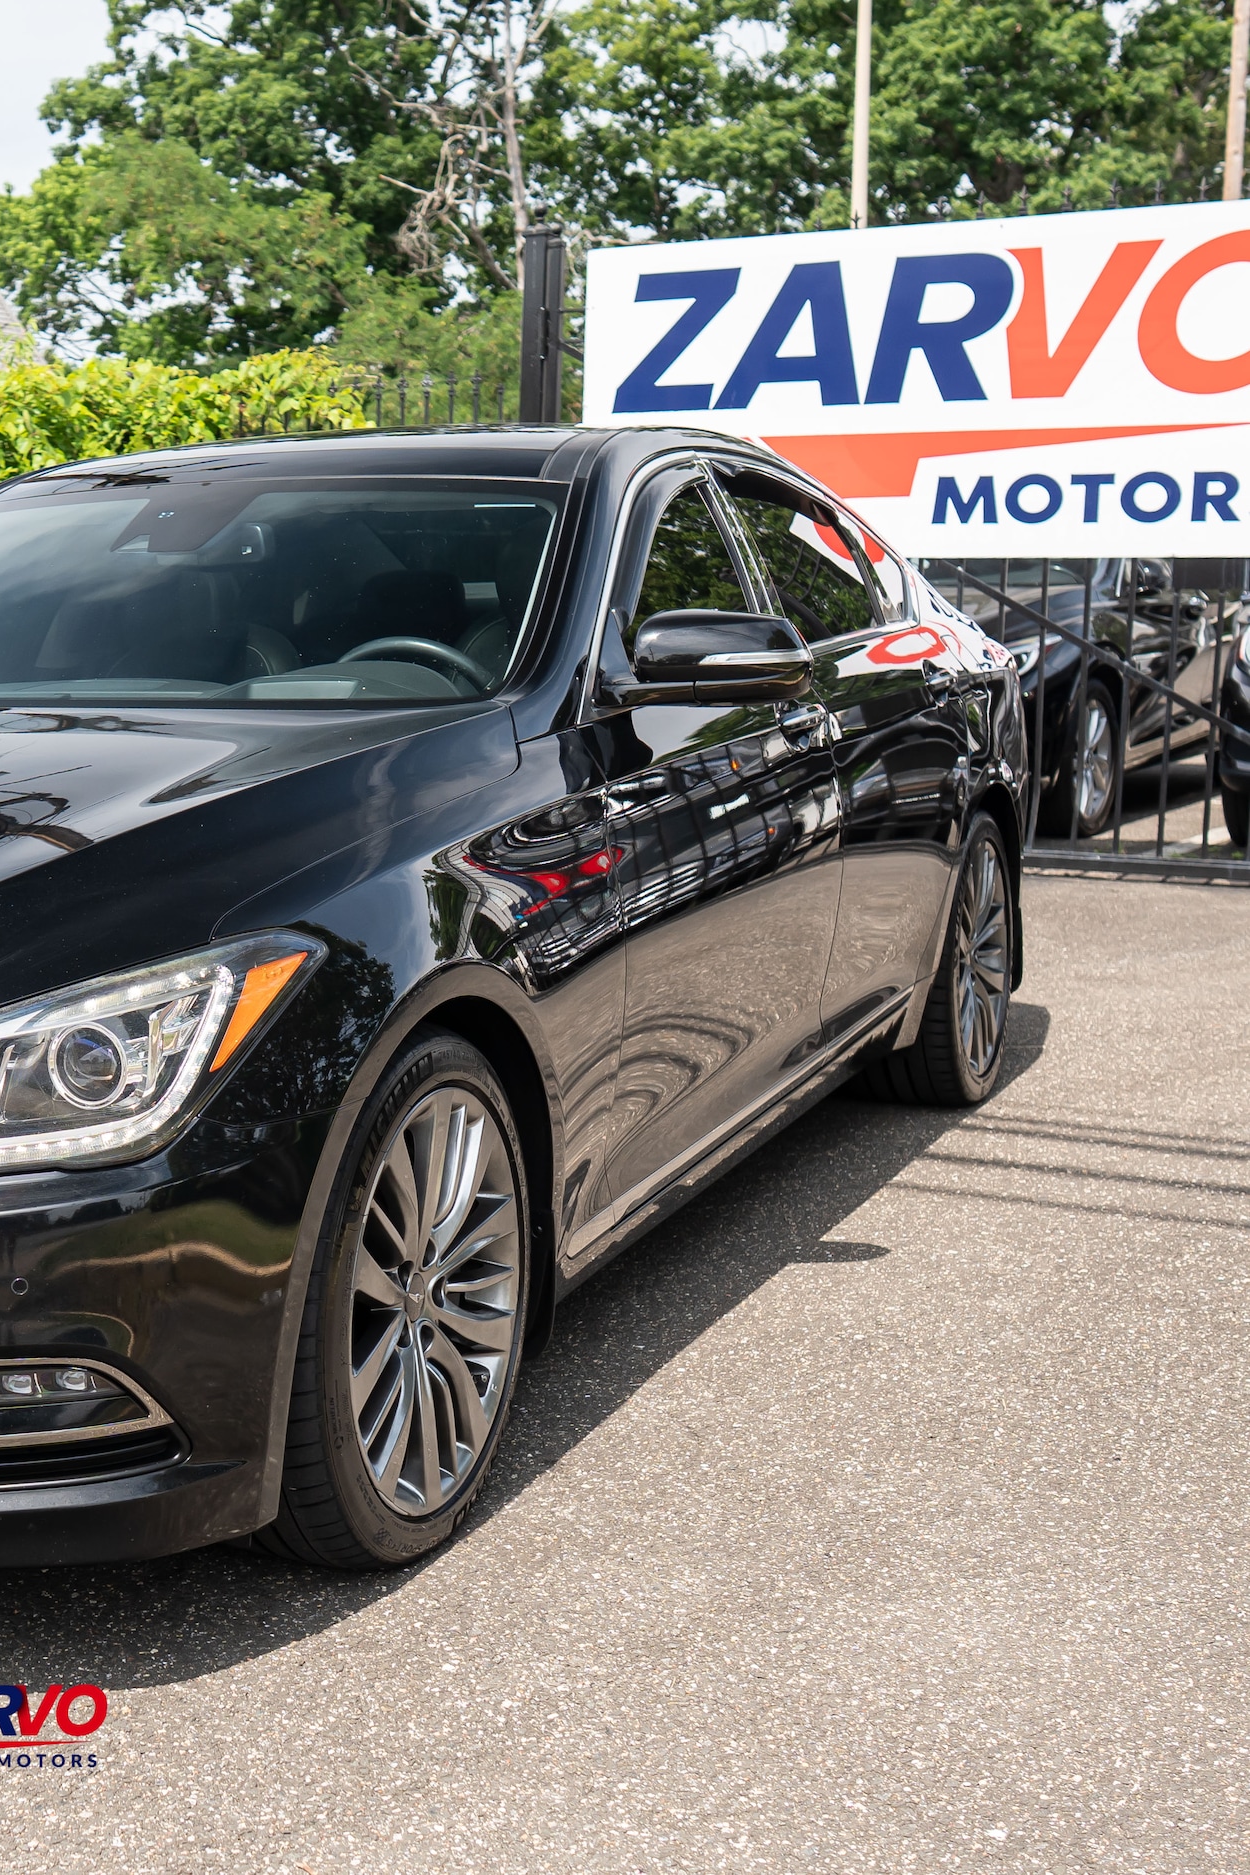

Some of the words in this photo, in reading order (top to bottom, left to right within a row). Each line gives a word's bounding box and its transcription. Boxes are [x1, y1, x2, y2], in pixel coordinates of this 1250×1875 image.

[613, 229, 1250, 414] ZARVO
[932, 471, 1250, 525] MOTOR
[358, 1055, 432, 1179] MICHELIN
